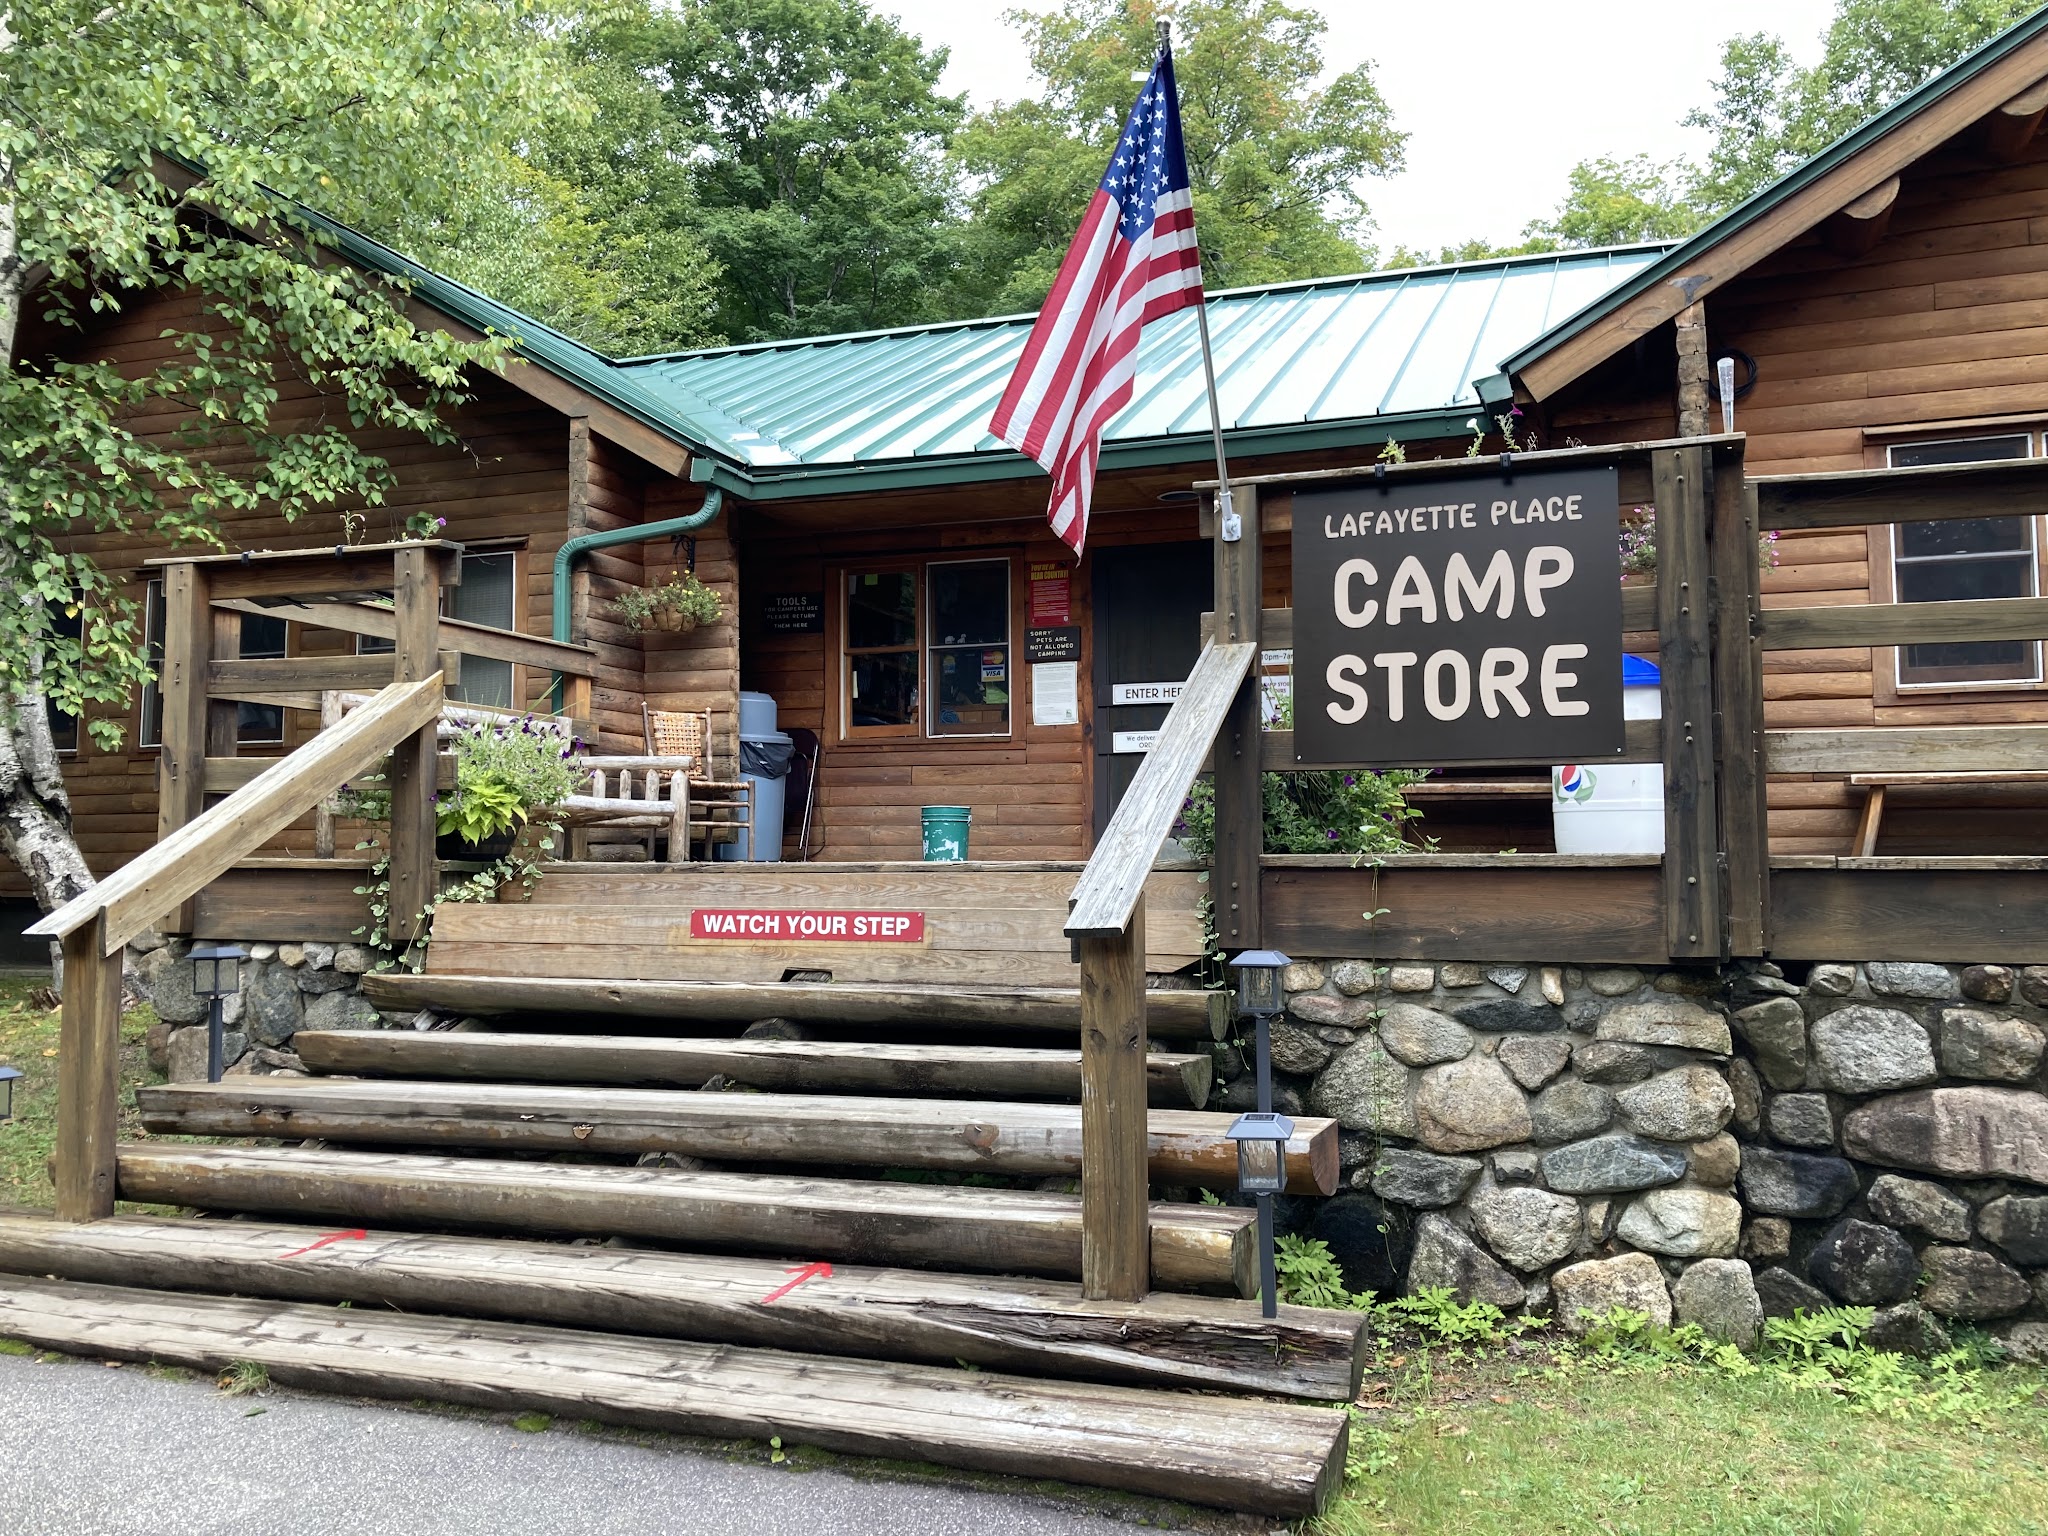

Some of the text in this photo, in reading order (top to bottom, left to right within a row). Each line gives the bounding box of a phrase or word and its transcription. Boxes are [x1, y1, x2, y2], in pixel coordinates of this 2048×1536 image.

[1324, 494, 1583, 539] LAFAYETTE PLACE
[1334, 546, 1575, 629] CAMP
[776, 597, 807, 606] TOOLS
[1045, 642, 1074, 650] ALLOWED
[1125, 688, 1159, 699] ENTER
[1326, 643, 1590, 725] STORE
[703, 914, 911, 936] WATCH YOUR STEP
